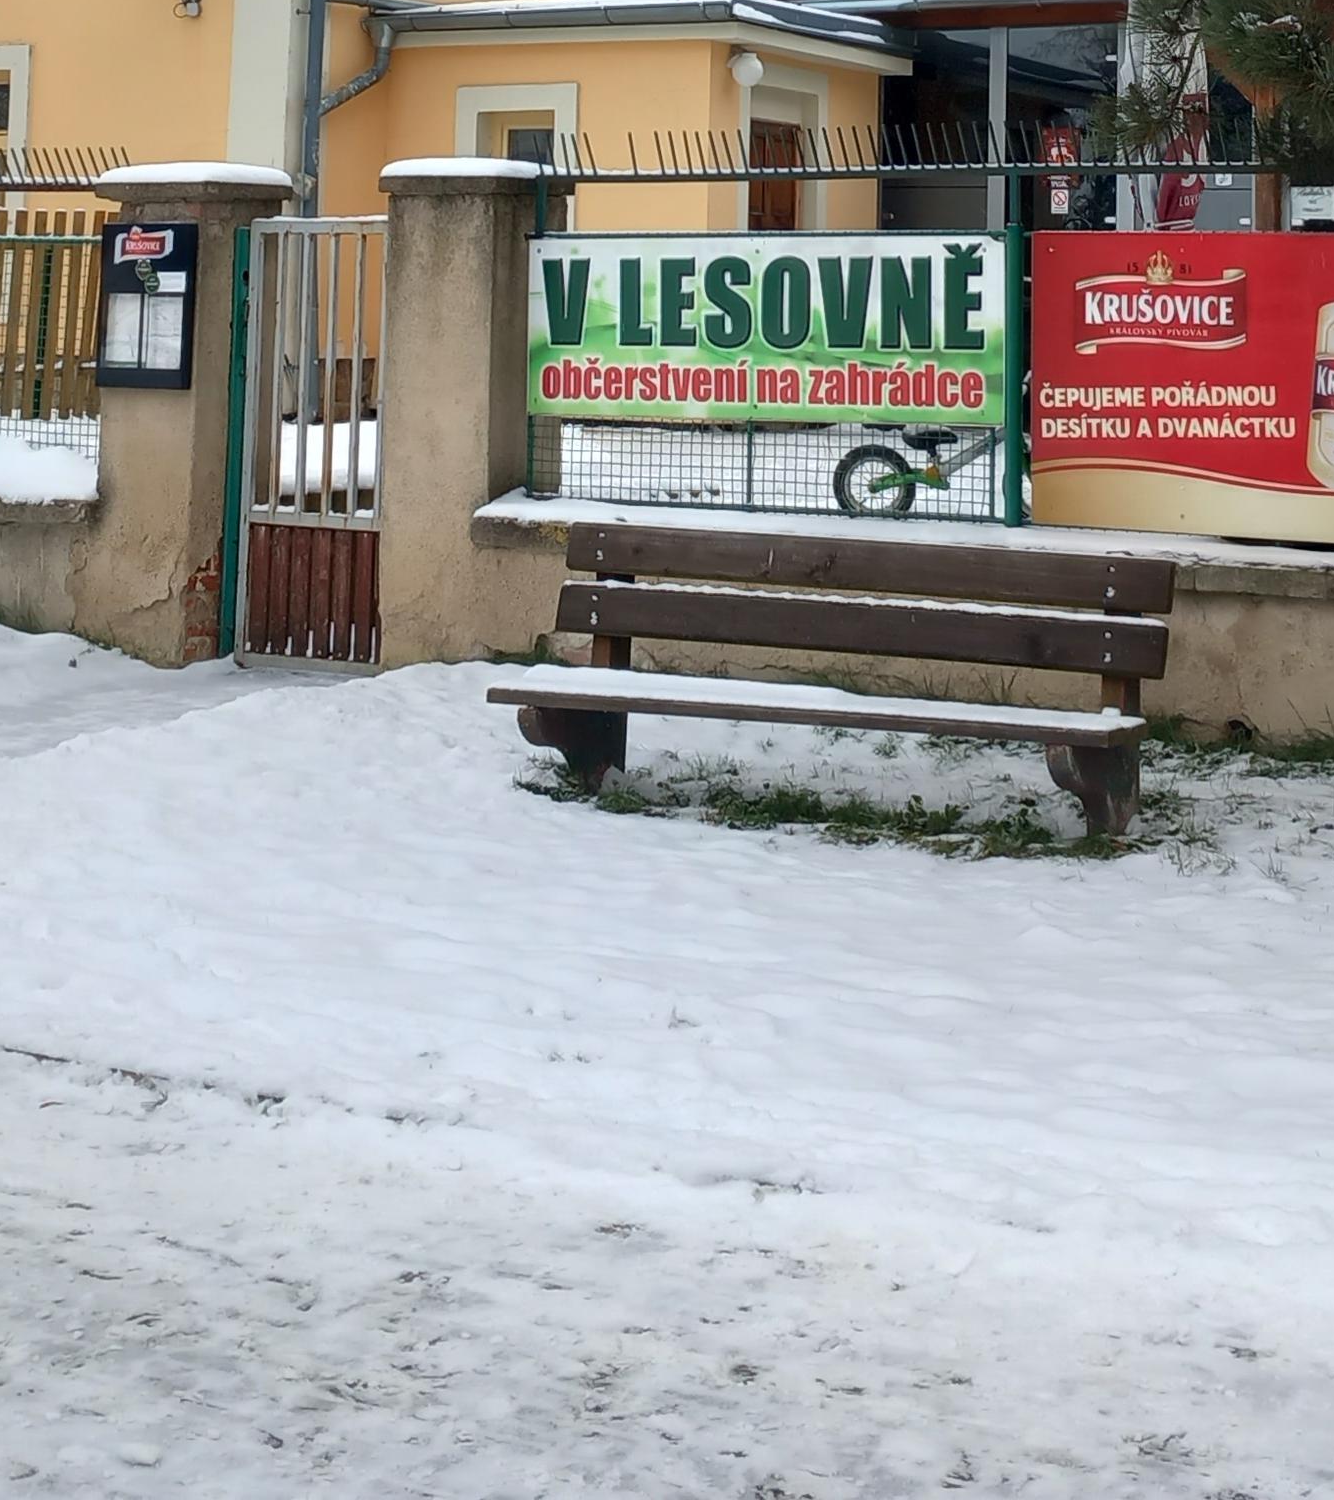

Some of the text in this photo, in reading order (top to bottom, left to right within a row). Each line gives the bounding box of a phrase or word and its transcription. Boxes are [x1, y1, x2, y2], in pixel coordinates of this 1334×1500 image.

[542, 242, 985, 350] V LESOVNĚ
[1085, 288, 1235, 326] KRUŠOVICE
[1109, 326, 1208, 337] KRÁLOVSKÝ PIVOVAR
[541, 357, 984, 409] občerstvení na zahrádce
[1039, 380, 1276, 412] ČEPUJEME POŘÁDNOU
[1041, 412, 1296, 439] DESÍTKU A DVANÁCTKU
